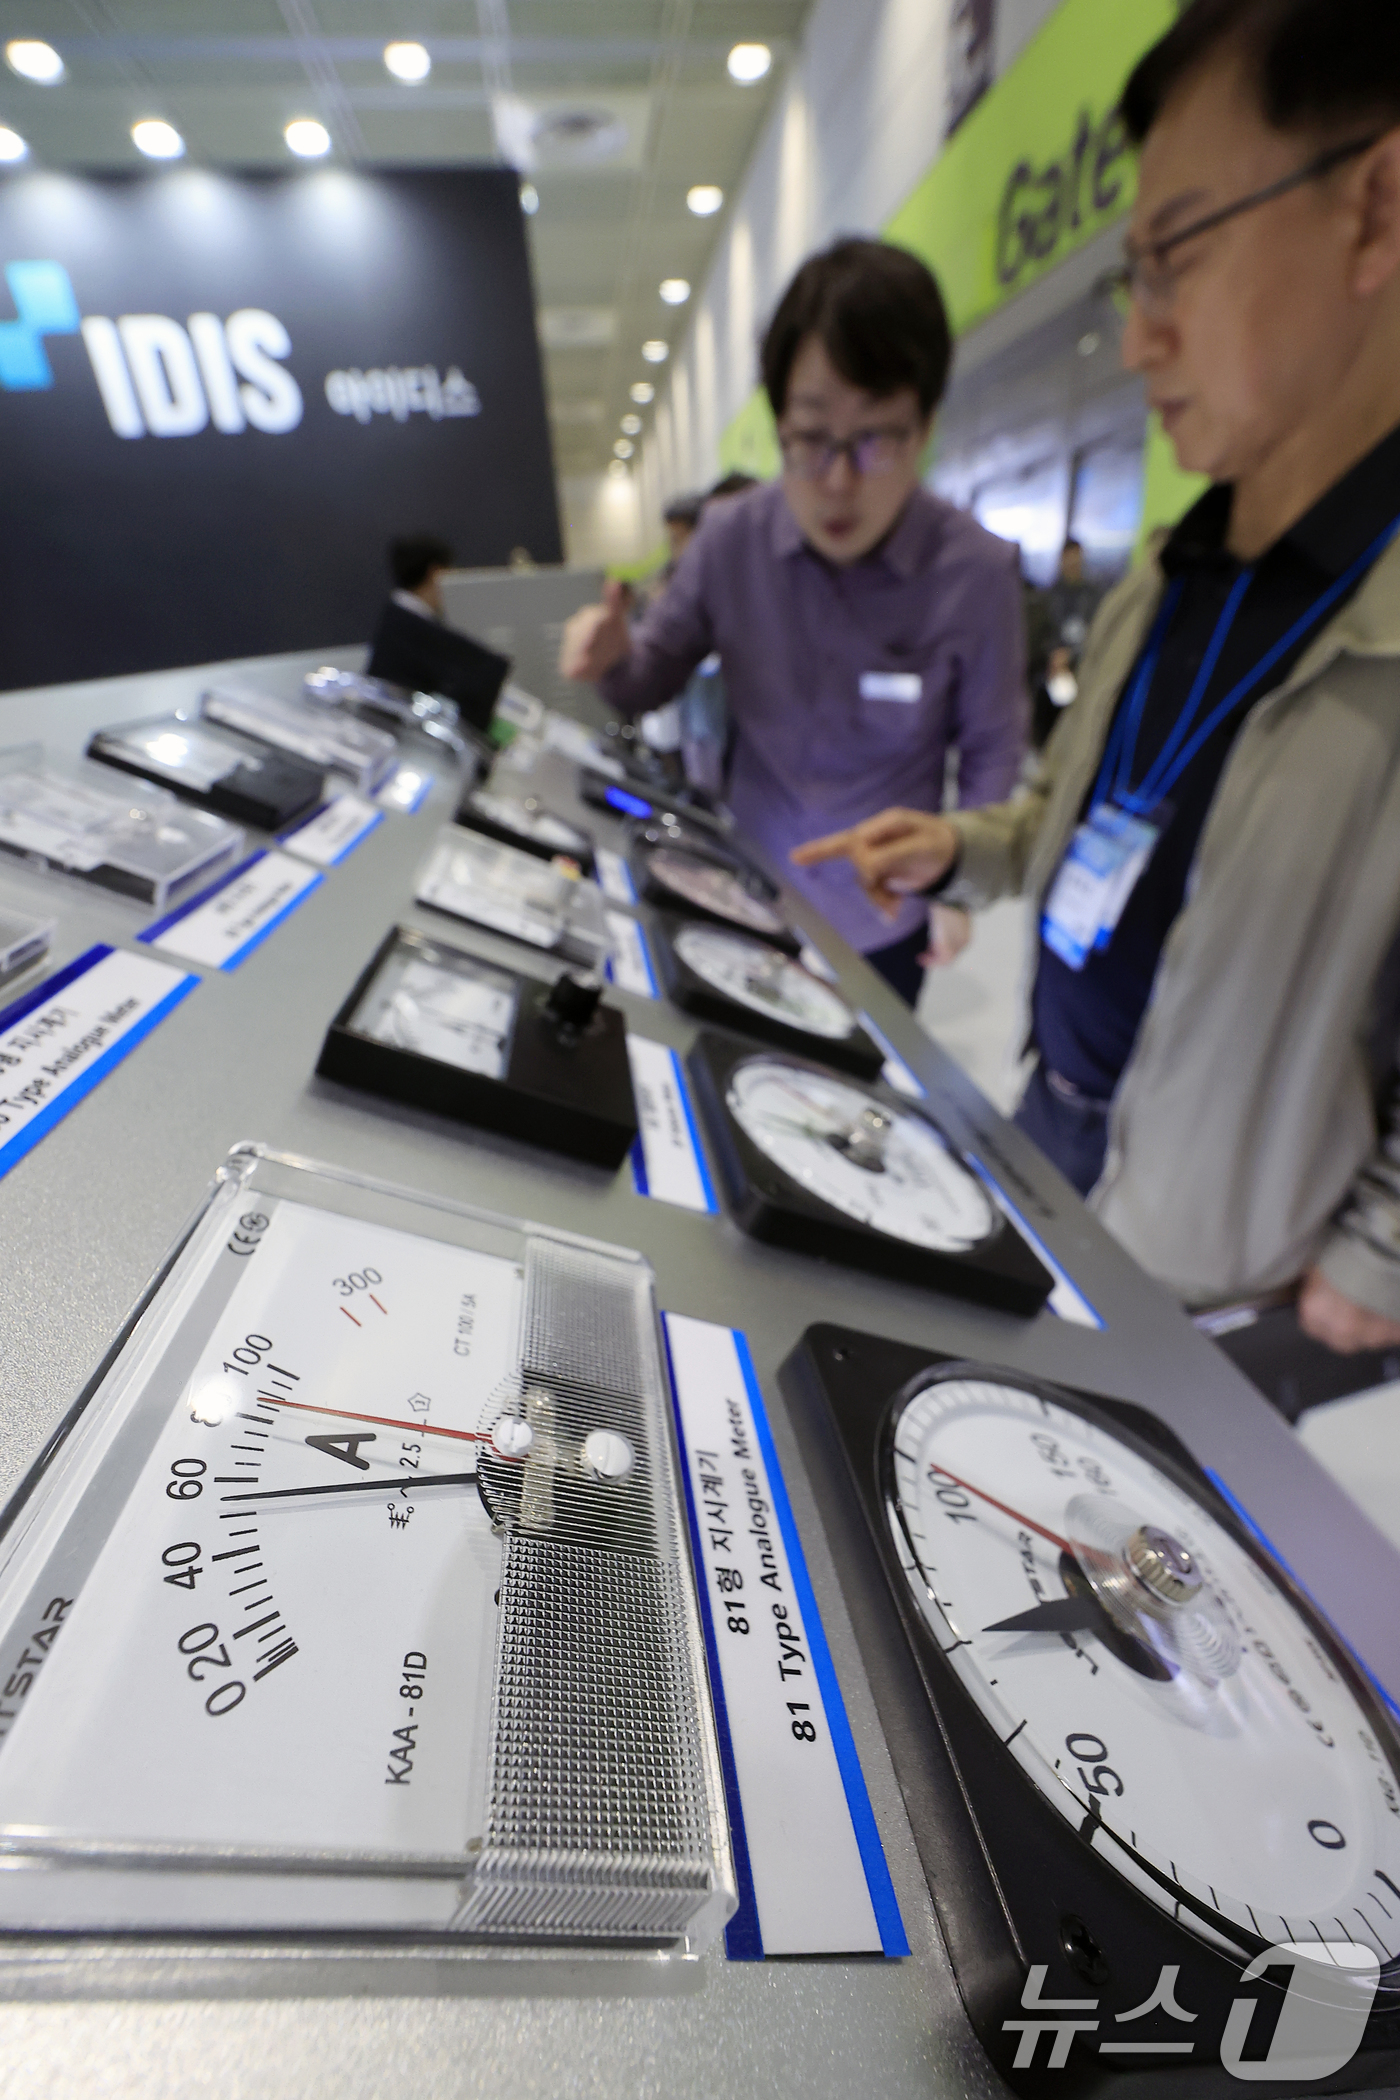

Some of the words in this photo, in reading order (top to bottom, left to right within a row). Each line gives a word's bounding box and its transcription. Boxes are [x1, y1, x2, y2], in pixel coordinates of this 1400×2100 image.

[80, 308, 303, 440] IDIS
[332, 1267, 383, 1297] 300
[223, 1334, 273, 1376] 100
[305, 1433, 377, 1471] A
[726, 1398, 752, 1460] Meter
[166, 1458, 208, 1500] 60
[399, 1443, 422, 1469] 2.5
[695, 1449, 733, 1553] 지시계기
[927, 1471, 978, 1524] 100
[741, 1468, 783, 1593] Analogue
[161, 1541, 204, 1590] 40
[714, 1567, 750, 1635] 81형
[177, 1623, 232, 1682] 20
[772, 1603, 806, 1682] Type
[205, 1681, 247, 1717] 0
[399, 1651, 428, 1700] 81D
[786, 1702, 817, 1743] 81
[384, 1724, 419, 1785] KAA
[1065, 1732, 1125, 1797] 50
[1307, 1820, 1347, 1850] 0
